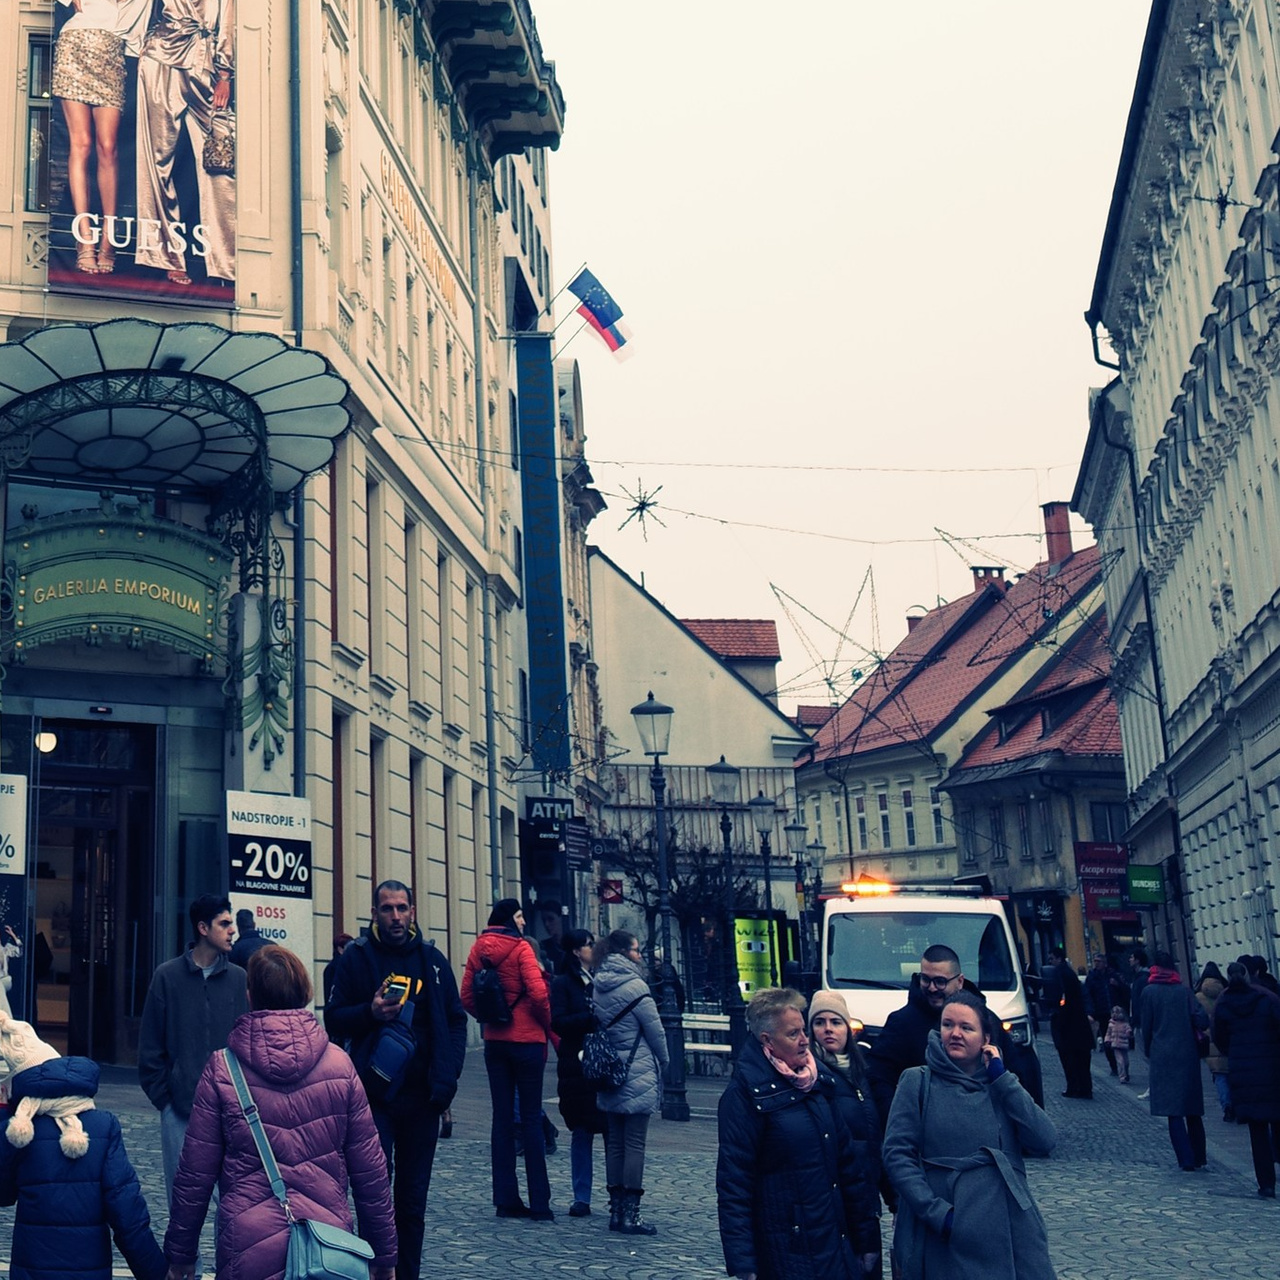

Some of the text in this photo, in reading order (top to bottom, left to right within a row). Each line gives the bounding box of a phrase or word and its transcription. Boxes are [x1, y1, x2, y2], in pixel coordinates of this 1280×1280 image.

[71, 212, 212, 257] GUESS
[33, 578, 202, 616] GALERIJA EMPORIUM
[531, 802, 572, 819] ATM
[231, 811, 306, 828] NADSTROPJE -1
[231, 842, 308, 881] -20%
[1080, 864, 1104, 875] Escape
[235, 880, 306, 894] NA BLAGOVNE ZNAMKE
[1131, 879, 1160, 888] MUNCHIES
[256, 906, 286, 920] BOSS
[257, 927, 287, 940] HUGO
